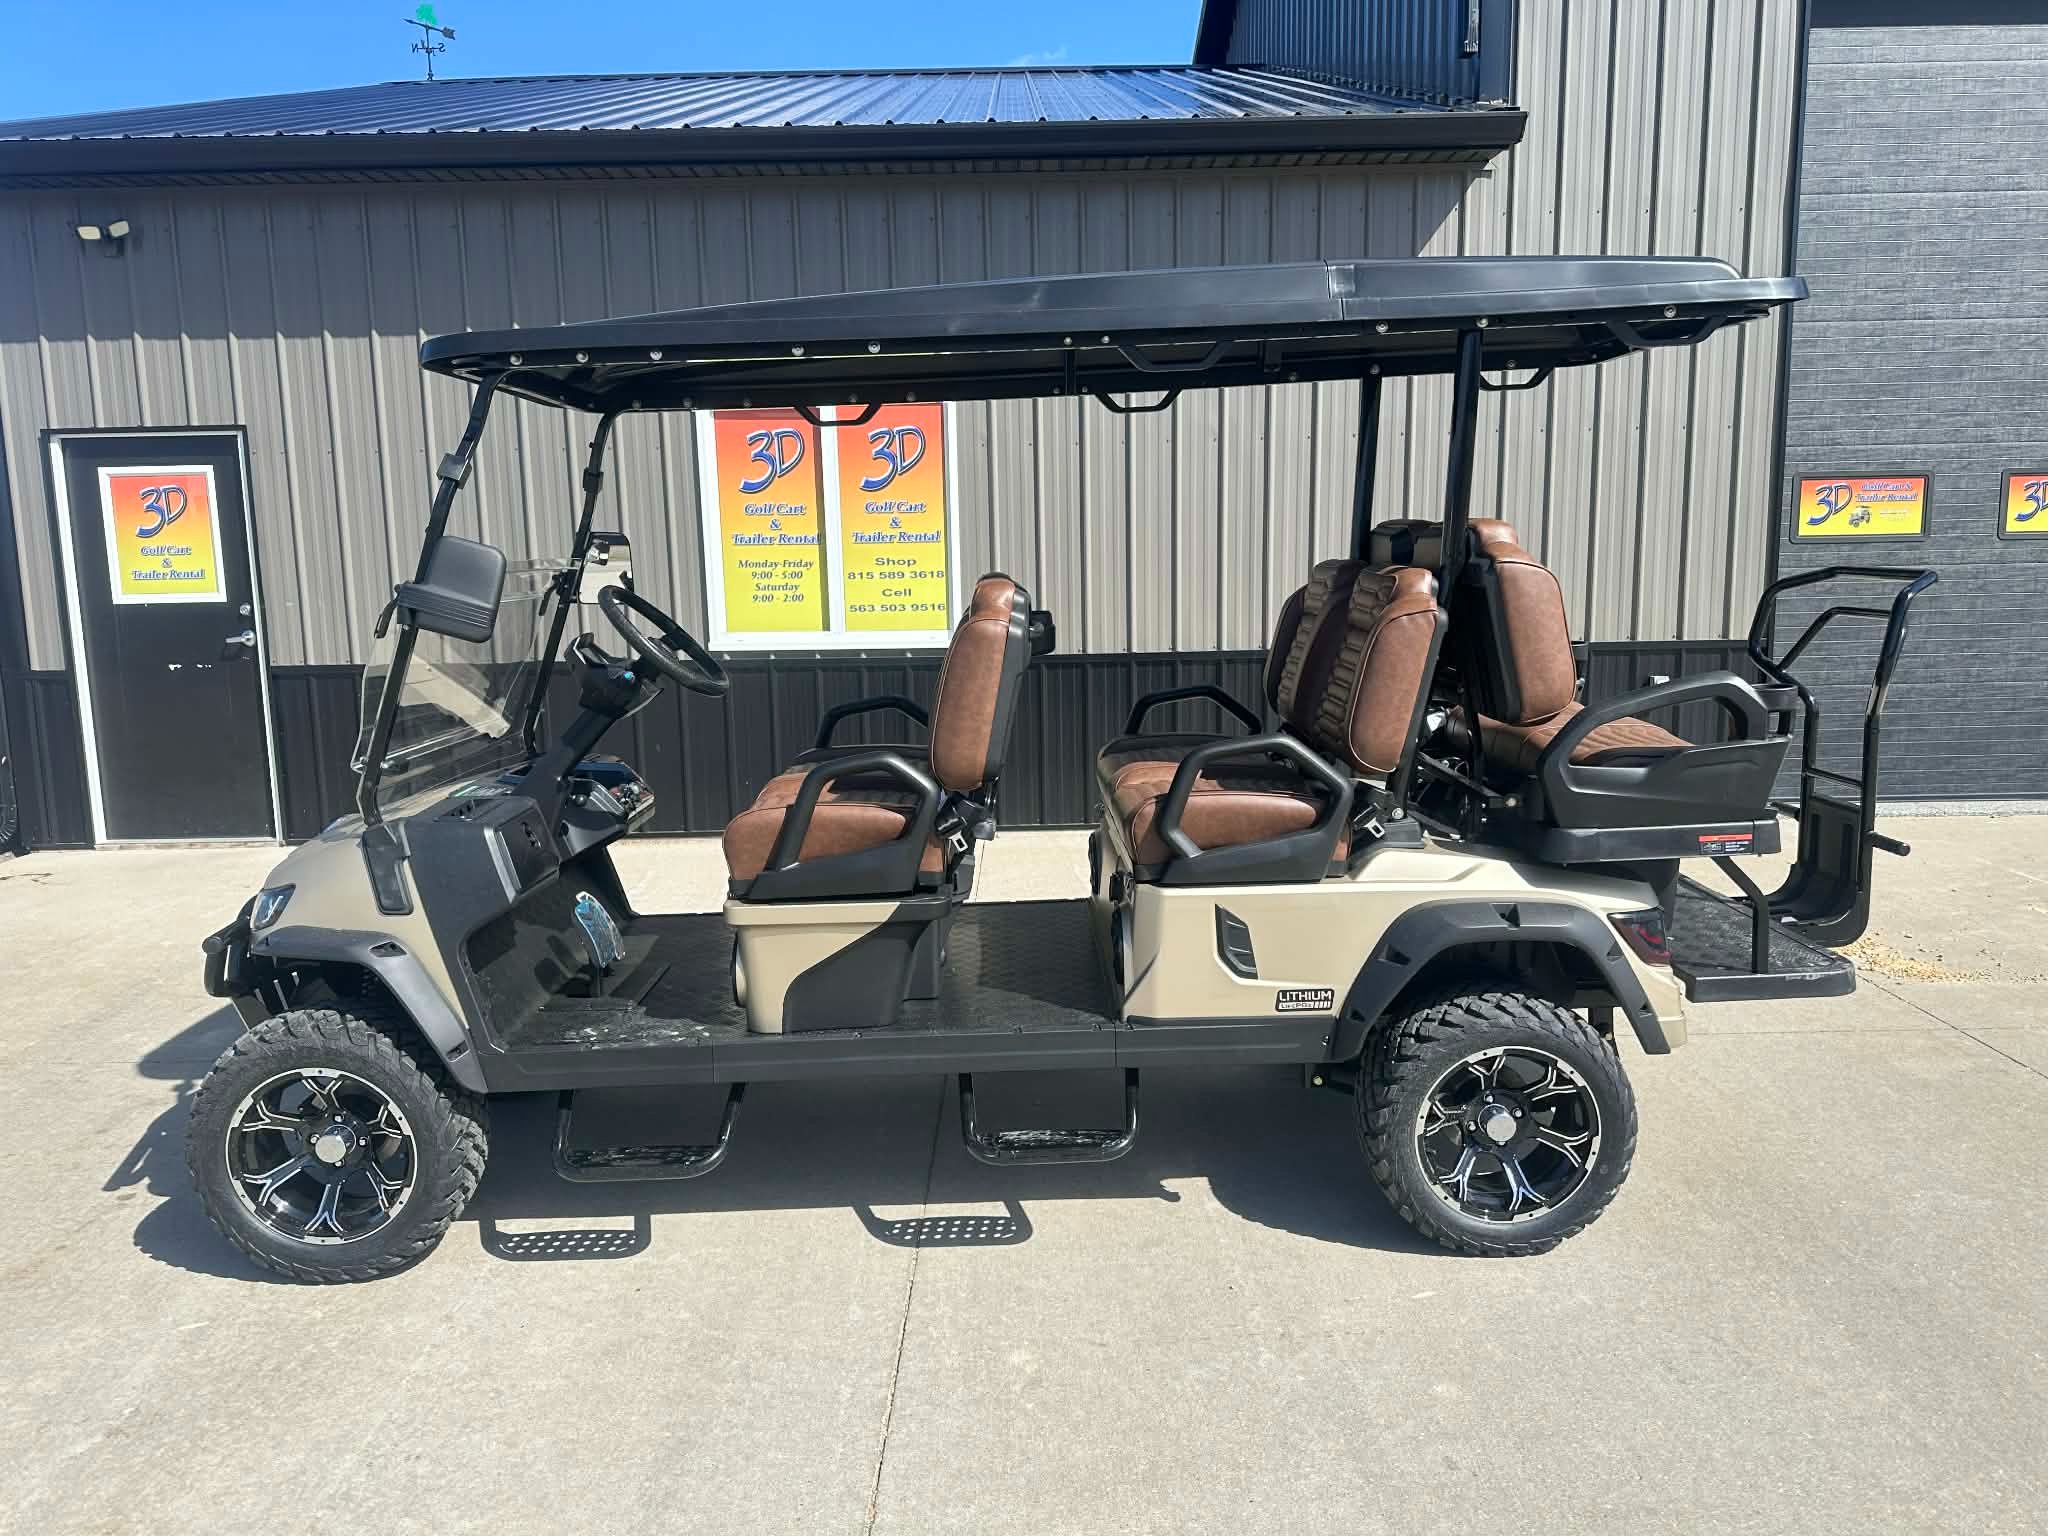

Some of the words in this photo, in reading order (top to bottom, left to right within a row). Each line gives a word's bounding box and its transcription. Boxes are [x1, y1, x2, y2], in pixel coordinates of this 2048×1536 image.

[739, 428, 804, 494] 3D
[859, 425, 926, 492] 3D
[865, 501, 896, 514] Golf
[896, 501, 927, 513] Cart
[1807, 482, 1853, 525] 3D
[136, 485, 188, 538] 3D
[745, 503, 776, 516] Golf
[776, 503, 807, 516] Cart
[770, 519, 782, 530] &
[889, 517, 902, 528] &
[733, 534, 777, 545] Trailer
[777, 533, 822, 545] Rental
[852, 532, 896, 544] Trailer
[896, 530, 941, 543] Rental
[141, 546, 166, 556] Golf
[162, 559, 172, 568] &
[875, 558, 917, 567] Shop
[132, 570, 169, 580] Trailer
[169, 569, 206, 580] Rental
[752, 571, 773, 580] 9:00
[782, 571, 804, 580] 5:00
[848, 571, 875, 580] 815
[880, 571, 905, 579] 589
[909, 570, 945, 579] 3618
[755, 583, 800, 593] Saturday
[882, 588, 912, 597] Cell
[753, 594, 774, 602] 9:00
[783, 594, 805, 602] 2:00
[849, 604, 876, 613] 563
[880, 603, 906, 612] 503
[911, 603, 946, 612] 9516
[1279, 991, 1332, 1002] LITHIUM
